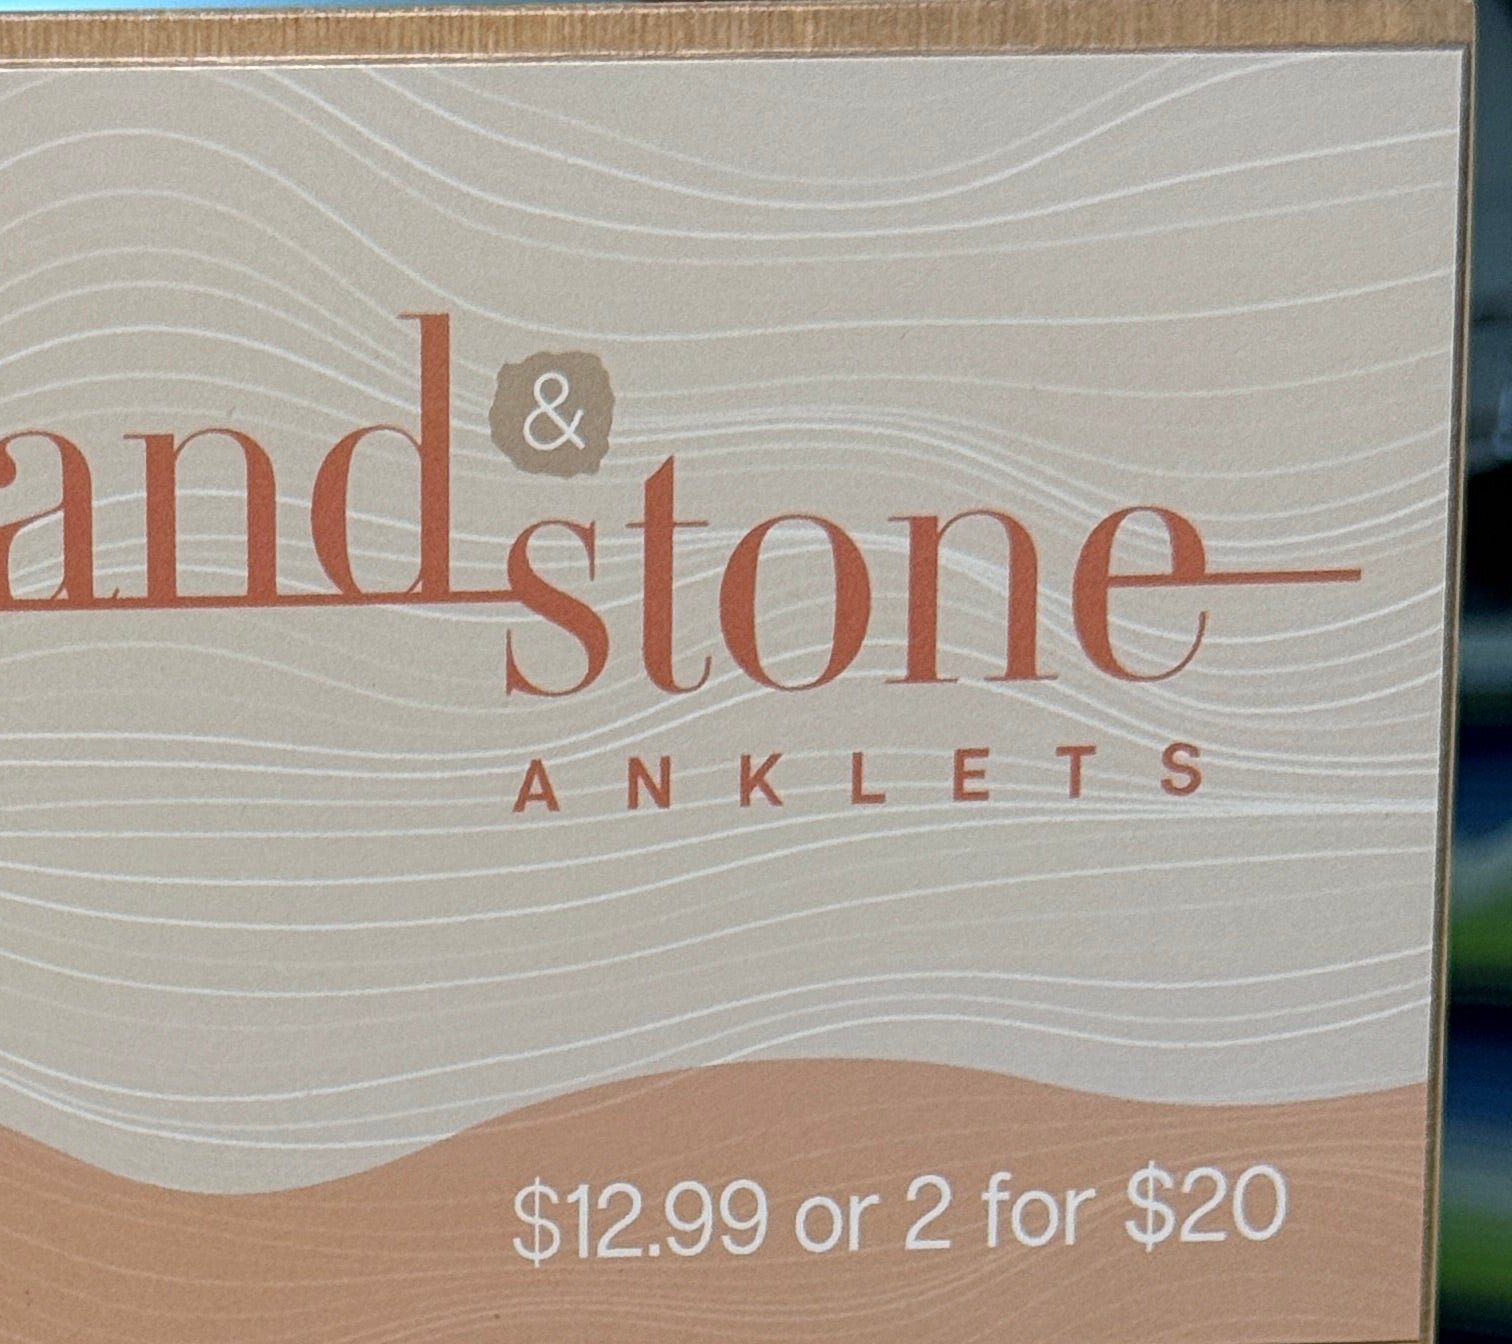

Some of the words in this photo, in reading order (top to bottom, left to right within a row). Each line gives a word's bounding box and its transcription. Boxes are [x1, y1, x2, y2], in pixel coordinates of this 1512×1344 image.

[521, 370, 586, 452] &
[503, 454, 1211, 698] stone
[512, 741, 1206, 814] ANKLETS
[512, 1175, 770, 1268] $12.99
[794, 1192, 882, 1254] or
[904, 1174, 952, 1251] 2
[981, 1171, 1097, 1248] for
[1124, 1159, 1288, 1253] $20
